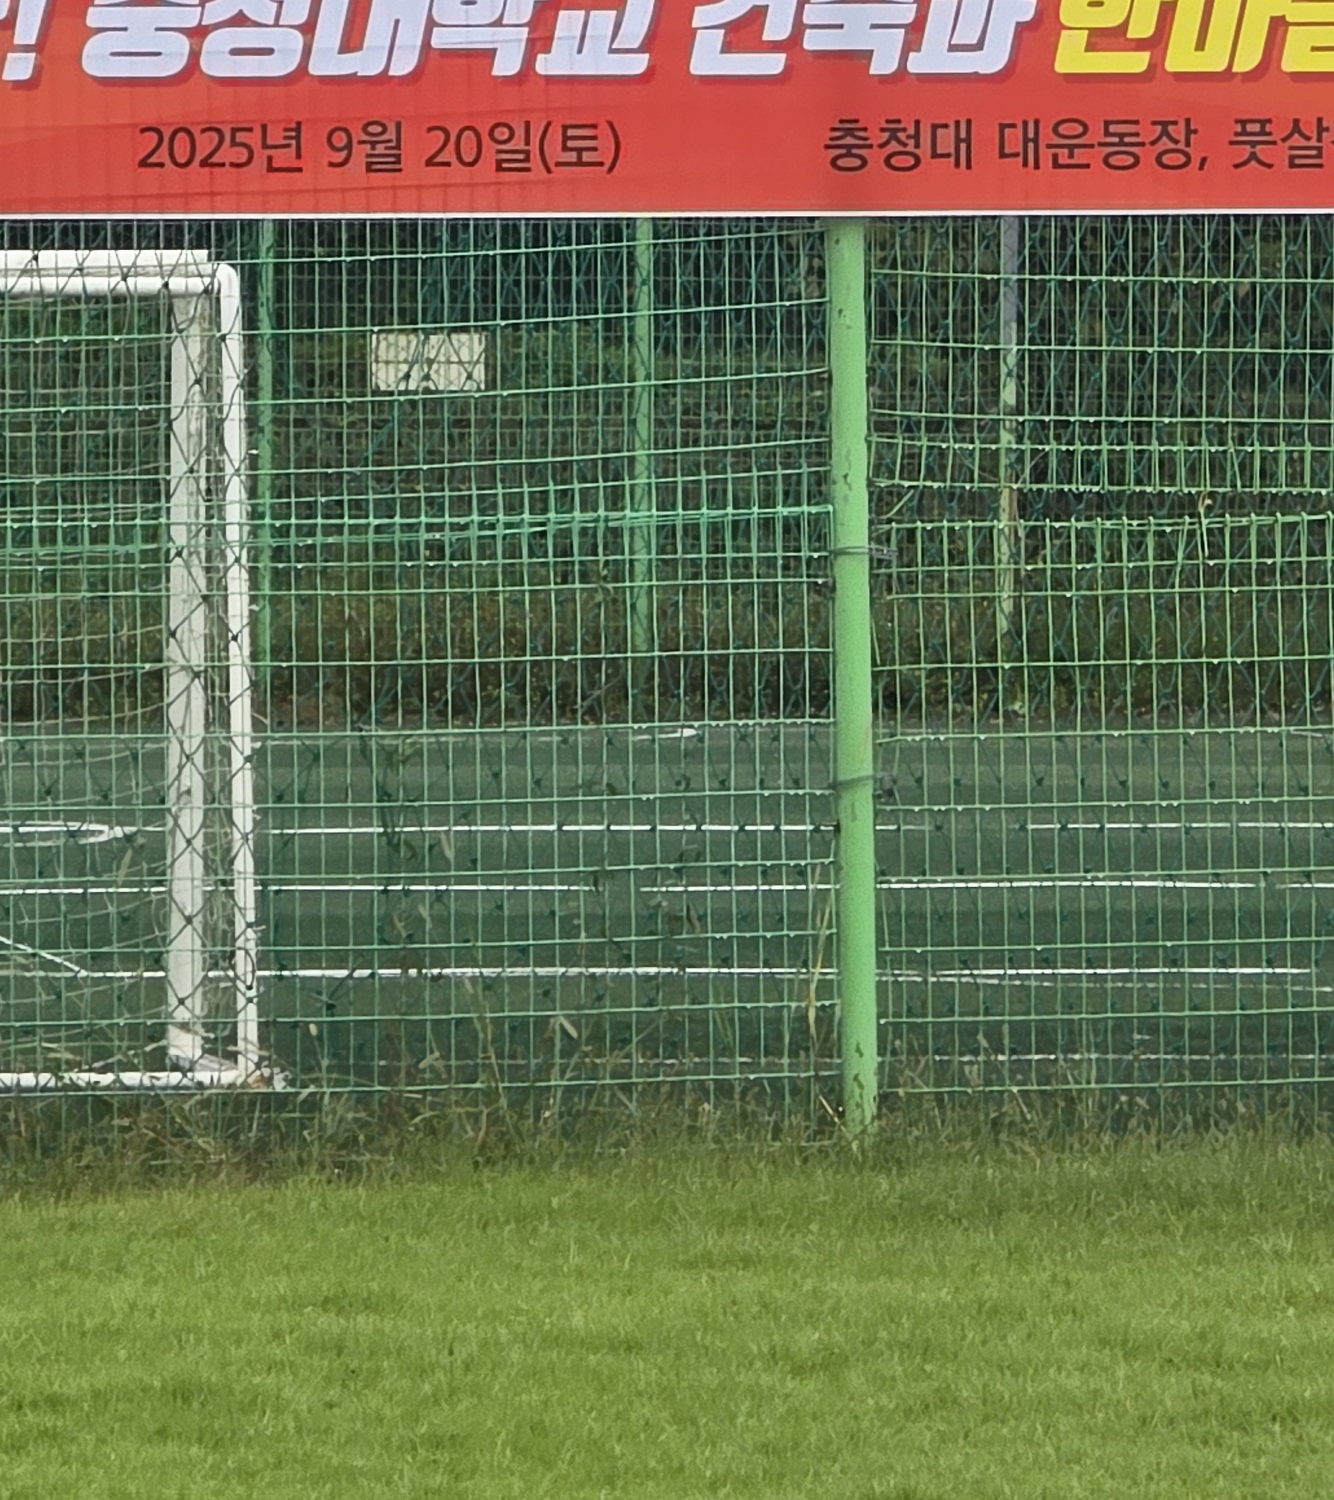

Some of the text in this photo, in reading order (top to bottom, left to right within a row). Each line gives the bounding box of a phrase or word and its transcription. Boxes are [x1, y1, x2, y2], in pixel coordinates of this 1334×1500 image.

[137, 118, 621, 176] 2025년 9월 20일(토)
[823, 117, 973, 173] 충청대
[997, 116, 1208, 173] 대운동장,
